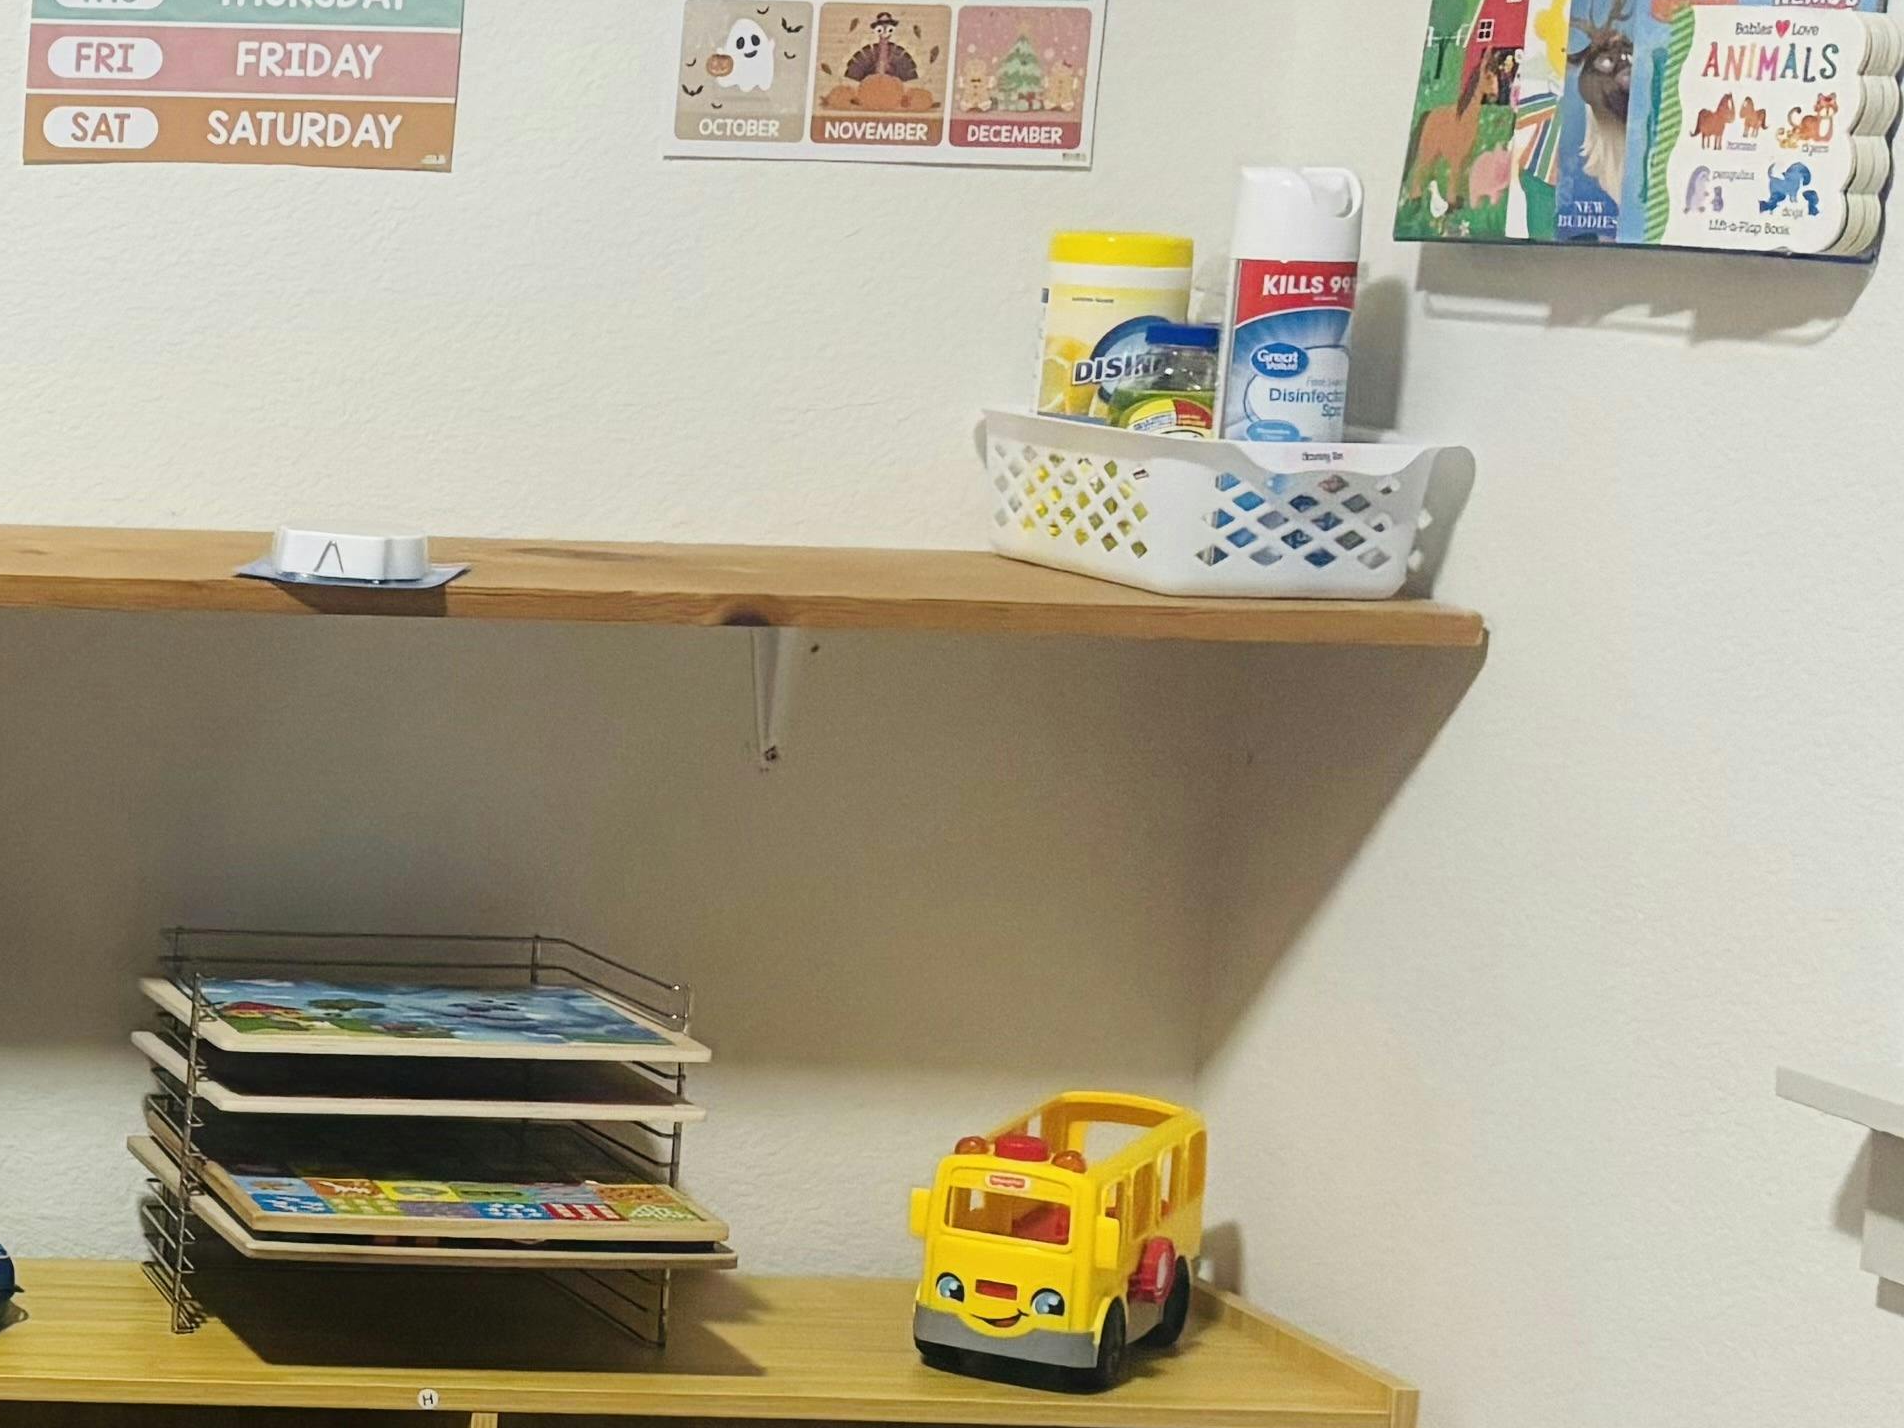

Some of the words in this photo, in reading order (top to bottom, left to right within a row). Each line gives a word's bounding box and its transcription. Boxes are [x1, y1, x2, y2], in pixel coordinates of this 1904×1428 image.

[1735, 22, 1774, 37] Babies
[1792, 23, 1819, 37] Love
[74, 42, 135, 73] FRI
[235, 41, 383, 80] FRIDAY
[1702, 41, 1839, 83] ANIMALS
[71, 112, 131, 142] SAT
[206, 110, 403, 150] SATURDAY
[825, 122, 928, 141] NOVEMBER
[967, 124, 1062, 144] DECEMBER
[1262, 274, 1324, 297] KILLS
